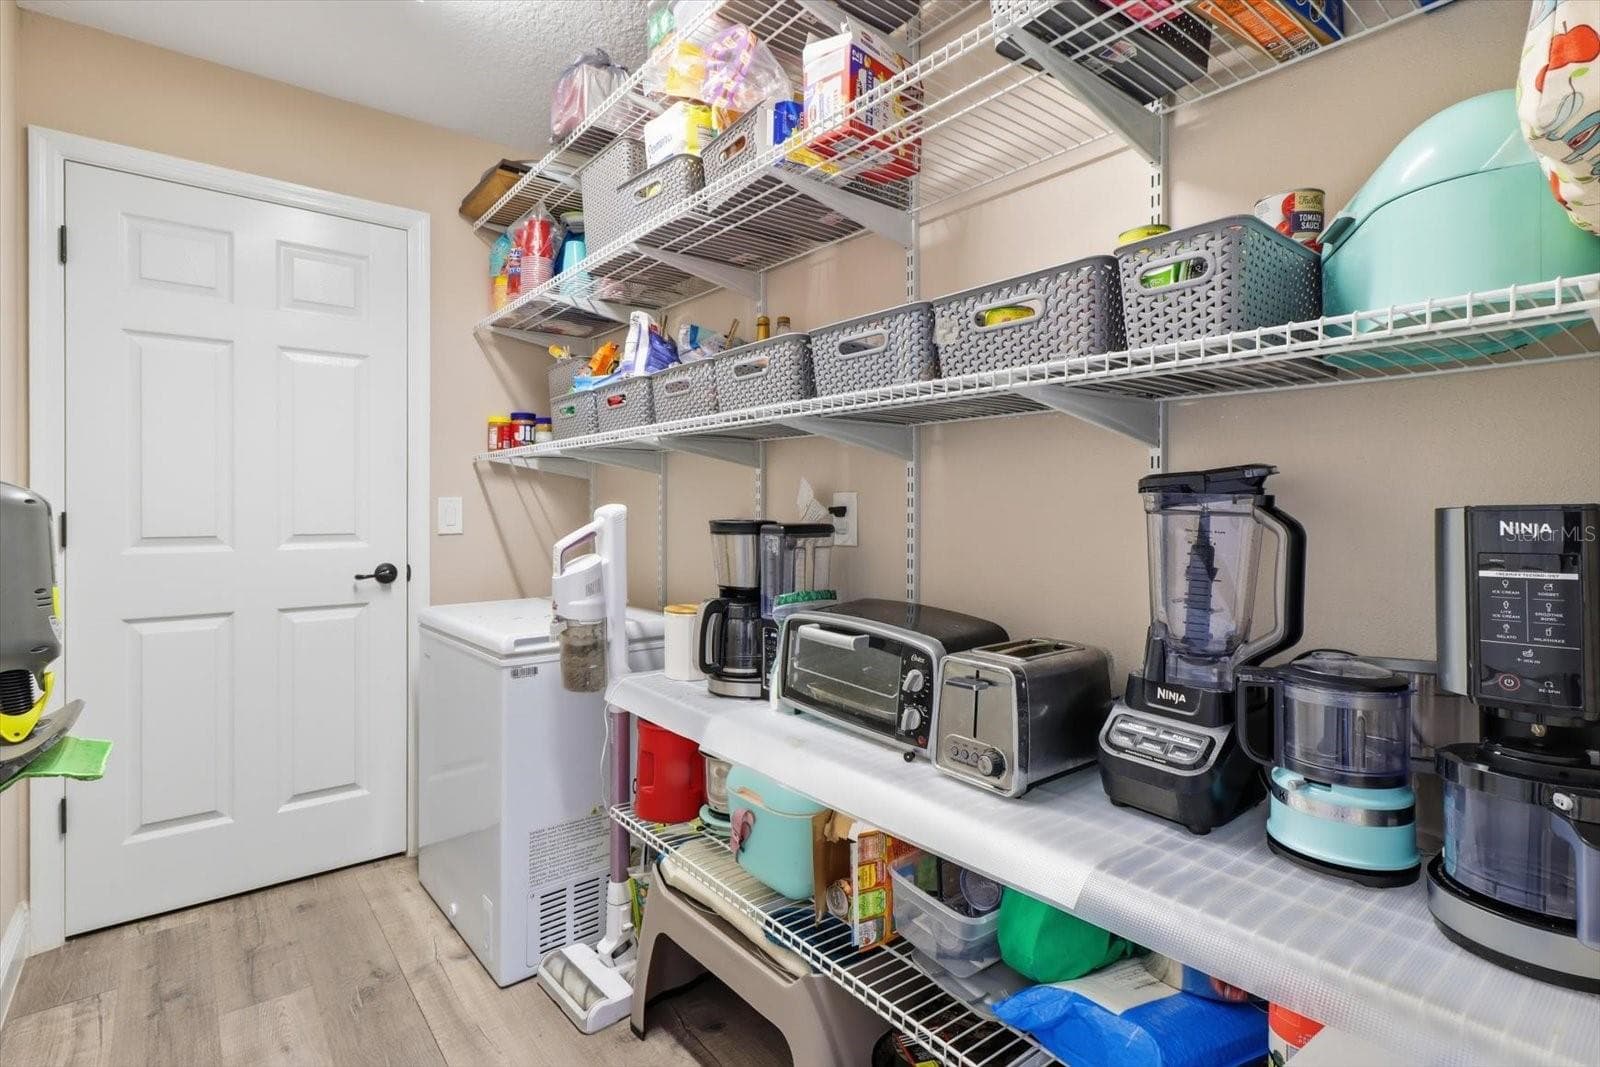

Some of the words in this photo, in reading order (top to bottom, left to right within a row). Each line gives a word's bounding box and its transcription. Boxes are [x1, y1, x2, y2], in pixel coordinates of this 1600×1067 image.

[1301, 222, 1320, 230] SAUCE
[1499, 520, 1552, 537] NINJA
[1157, 687, 1186, 705] NINJA
